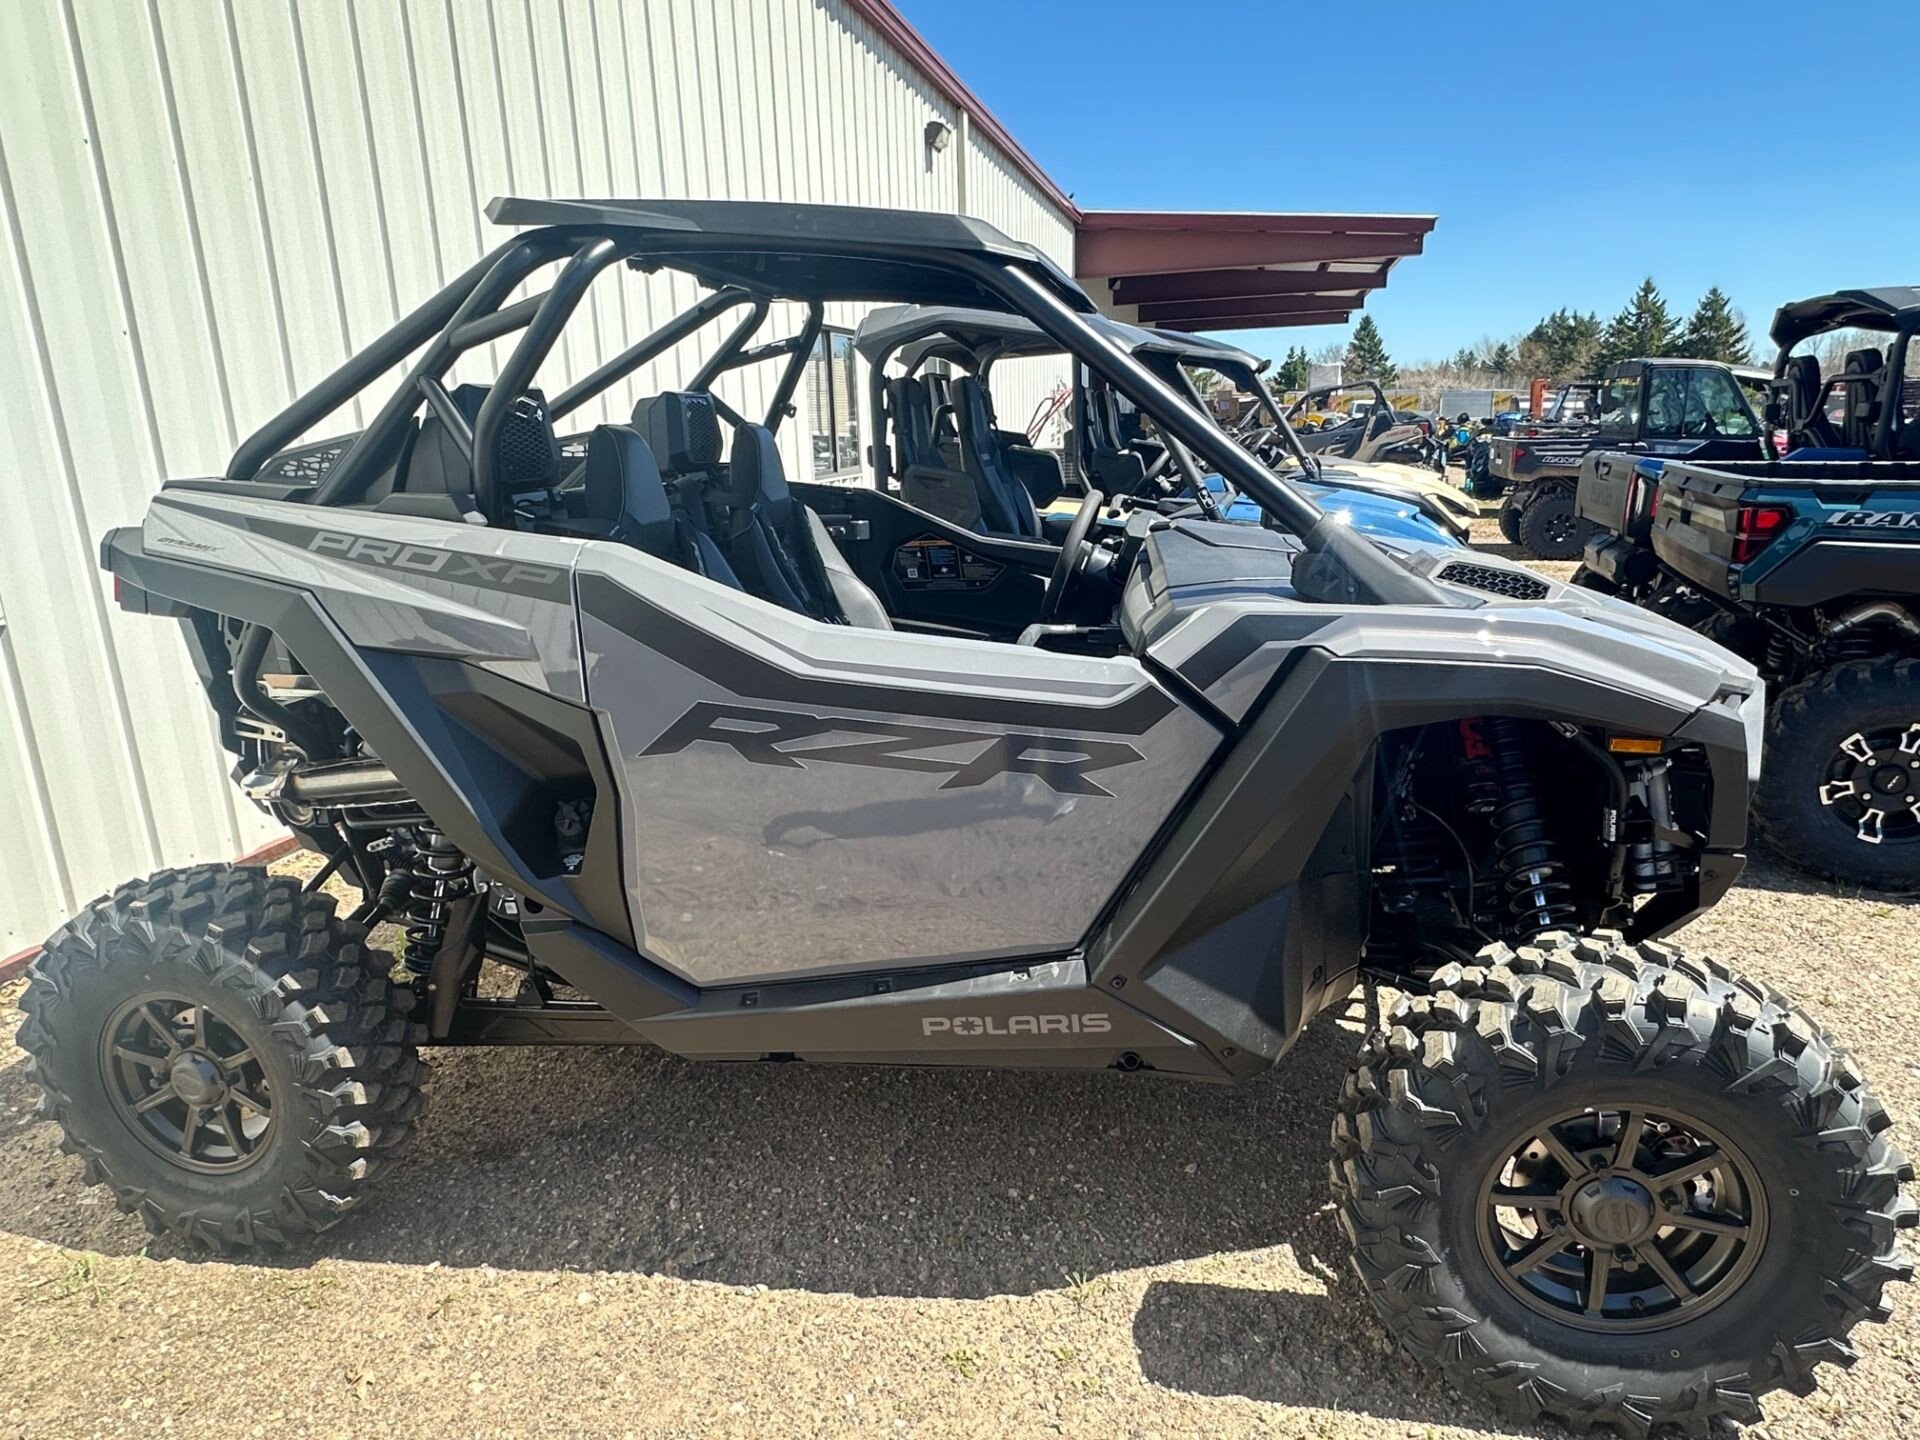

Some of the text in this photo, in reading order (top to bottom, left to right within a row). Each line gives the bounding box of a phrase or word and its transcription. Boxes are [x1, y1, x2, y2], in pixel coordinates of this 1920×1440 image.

[307, 531, 561, 585] PRO XP
[637, 700, 1147, 798] RZR
[921, 1012, 1112, 1036] POLARIS
